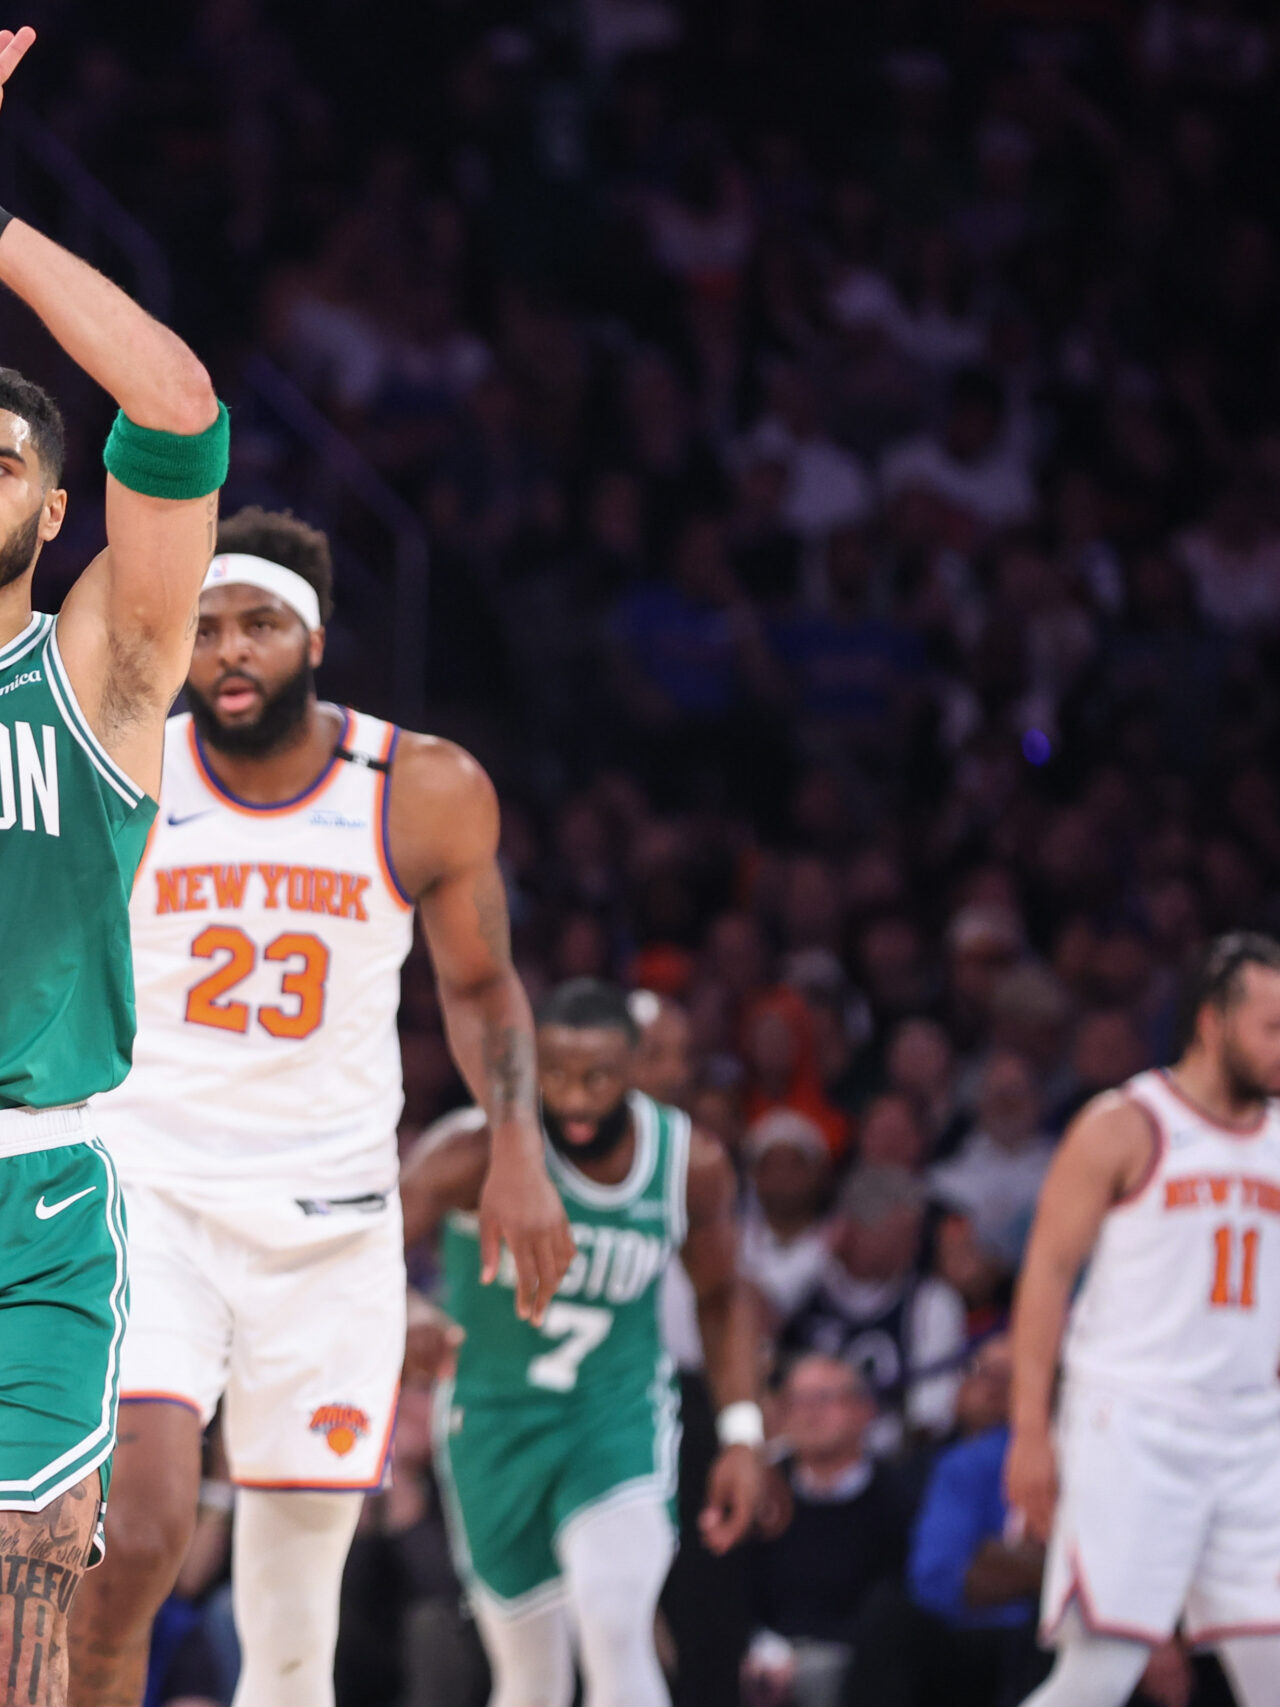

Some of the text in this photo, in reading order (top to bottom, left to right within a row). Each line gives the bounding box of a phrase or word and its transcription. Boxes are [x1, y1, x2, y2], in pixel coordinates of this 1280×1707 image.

[155, 864, 369, 922] NEW YORK
[185, 924, 329, 1039] 23
[1211, 1226, 1259, 1309] 11
[528, 1303, 613, 1391] 7
